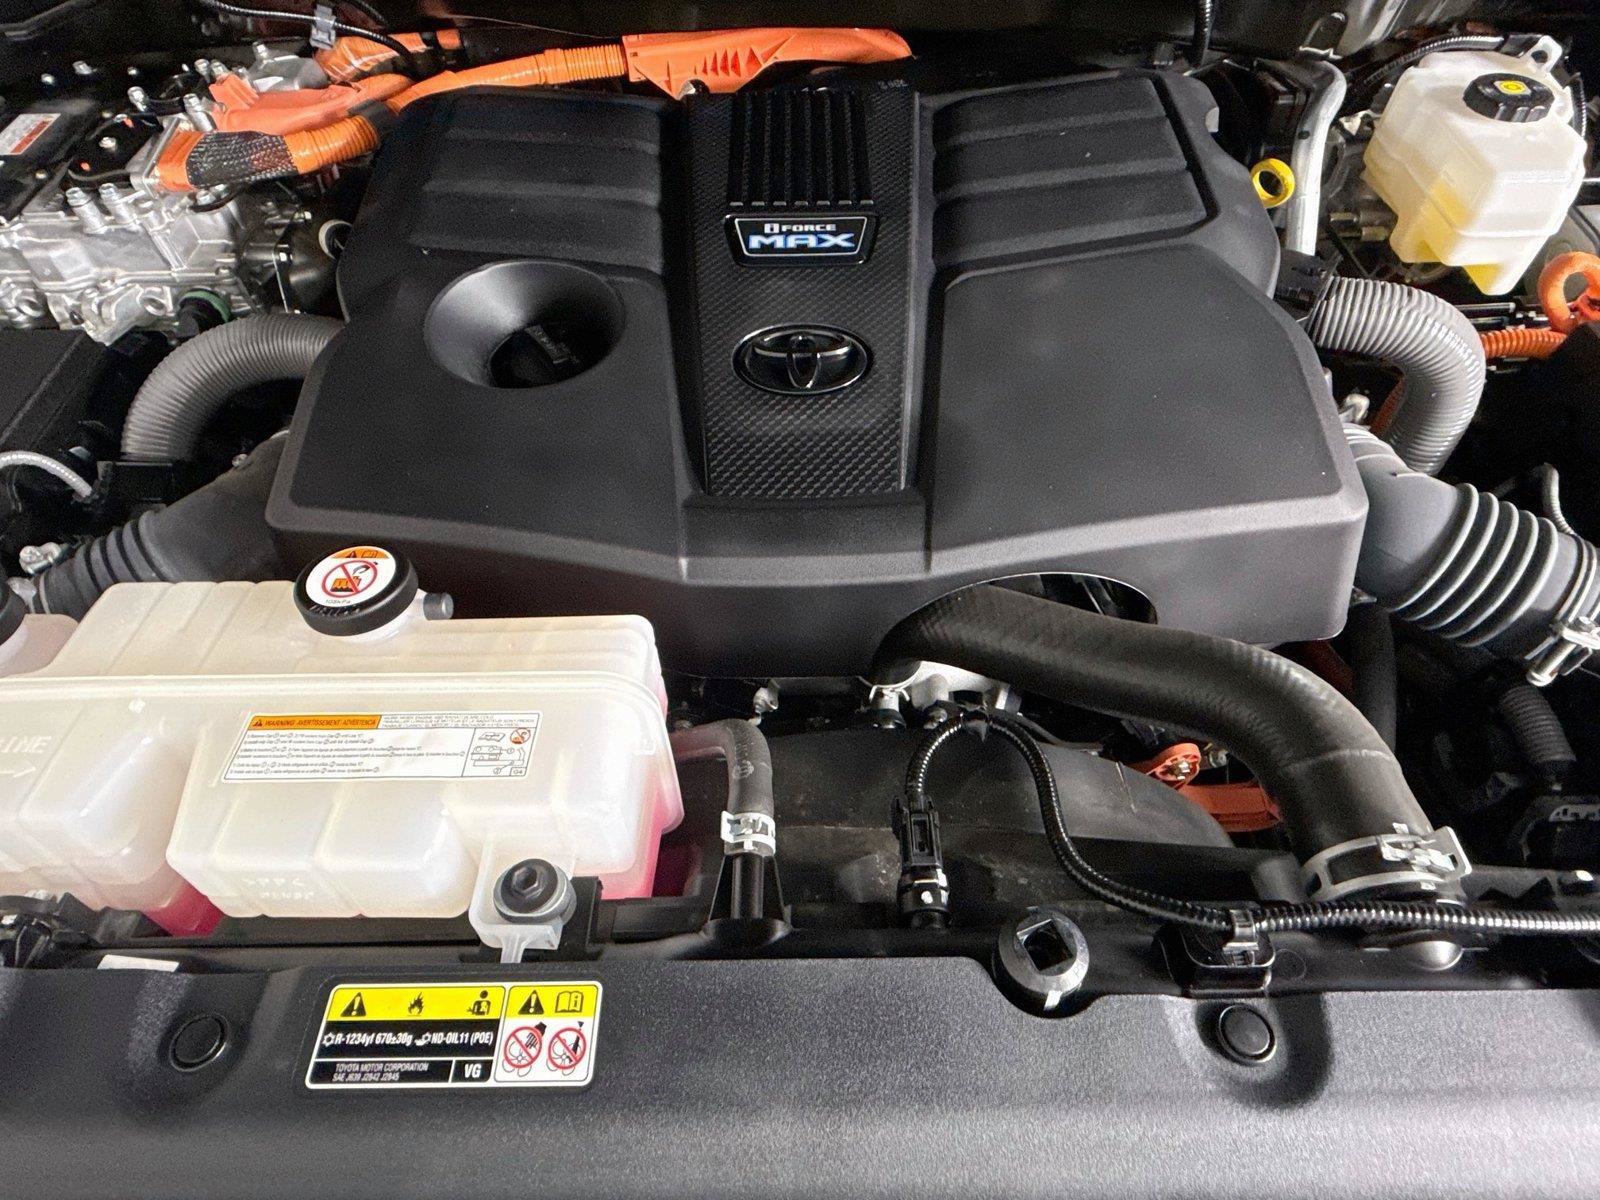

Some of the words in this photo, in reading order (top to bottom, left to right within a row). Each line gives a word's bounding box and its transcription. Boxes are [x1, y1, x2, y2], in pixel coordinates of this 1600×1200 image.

[781, 223, 837, 232] FORCE
[748, 232, 856, 249] MAX
[335, 1032, 374, 1046] R-1234yf
[375, 1032, 413, 1046] 670±30g
[431, 1031, 469, 1044] ND-OIL11
[470, 1031, 494, 1046] (POE)
[335, 1063, 360, 1071] TOYOTA
[361, 1063, 384, 1071] MOTOR
[384, 1062, 429, 1071] CORPORATION
[464, 1063, 482, 1079] VG
[332, 1073, 345, 1082] SAE
